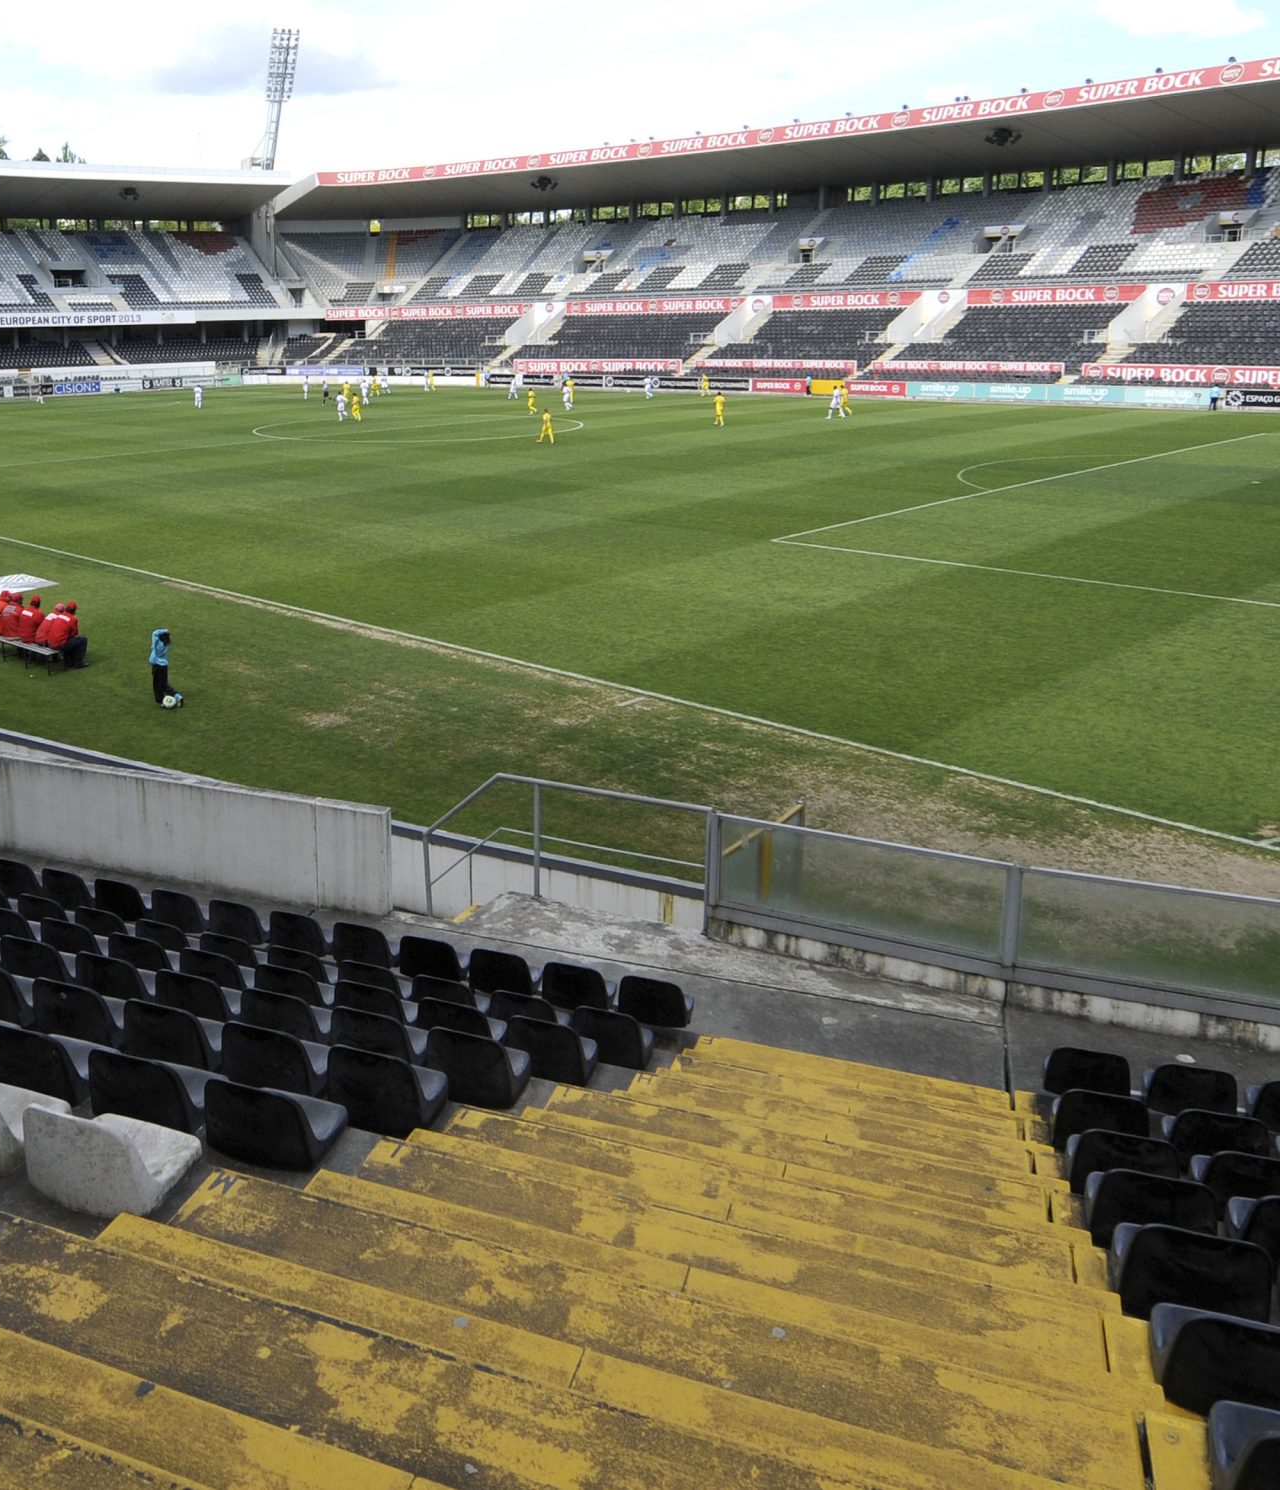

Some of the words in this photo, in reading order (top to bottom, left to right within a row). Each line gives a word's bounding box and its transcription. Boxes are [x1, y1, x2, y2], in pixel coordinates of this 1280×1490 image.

[1076, 79, 1140, 102] SUPER
[1143, 70, 1207, 93] BOCK
[920, 102, 975, 123] SUPER
[977, 95, 1032, 115] BOCK
[783, 121, 831, 140] SUPER
[833, 115, 881, 133] BOCK
[660, 137, 704, 153] SUPER
[706, 132, 749, 148] BOCK
[548, 150, 588, 165] SUPER
[591, 146, 629, 161] BOCK
[443, 161, 480, 175] SUPER
[483, 157, 519, 172] BOCK
[336, 171, 375, 184] SUPER
[378, 168, 412, 181] BOCK
[1011, 289, 1053, 302] SUPER
[1055, 287, 1096, 301] BOCK
[1217, 283, 1268, 298] SUPER
[662, 299, 694, 311] SUPER
[695, 298, 726, 310] BOCK
[810, 294, 845, 306] SUPER
[847, 293, 880, 305] BOCK
[401, 307, 427, 318] SUPER
[428, 306, 454, 317] BOCK
[466, 306, 492, 317] SUPER
[494, 305, 519, 315] BOCK
[585, 301, 614, 312] SUPER
[615, 301, 644, 312] BOCK
[0, 315, 50, 326] EUROPEAN
[51, 315, 72, 325] CITY
[73, 315, 85, 324] OF
[87, 314, 117, 324] SPORT
[118, 314, 142, 323] 2013
[327, 308, 357, 320] SUPER
[358, 307, 385, 318] BOCK
[528, 361, 558, 372] SUPER
[559, 361, 588, 373] BOCK
[1160, 368, 1207, 383] BOCK
[54, 382, 92, 395] CISION
[774, 382, 790, 390] BOCK
[850, 383, 869, 392] SUPER
[870, 384, 888, 392] BOCK
[1245, 395, 1274, 404] ESPAÇO
